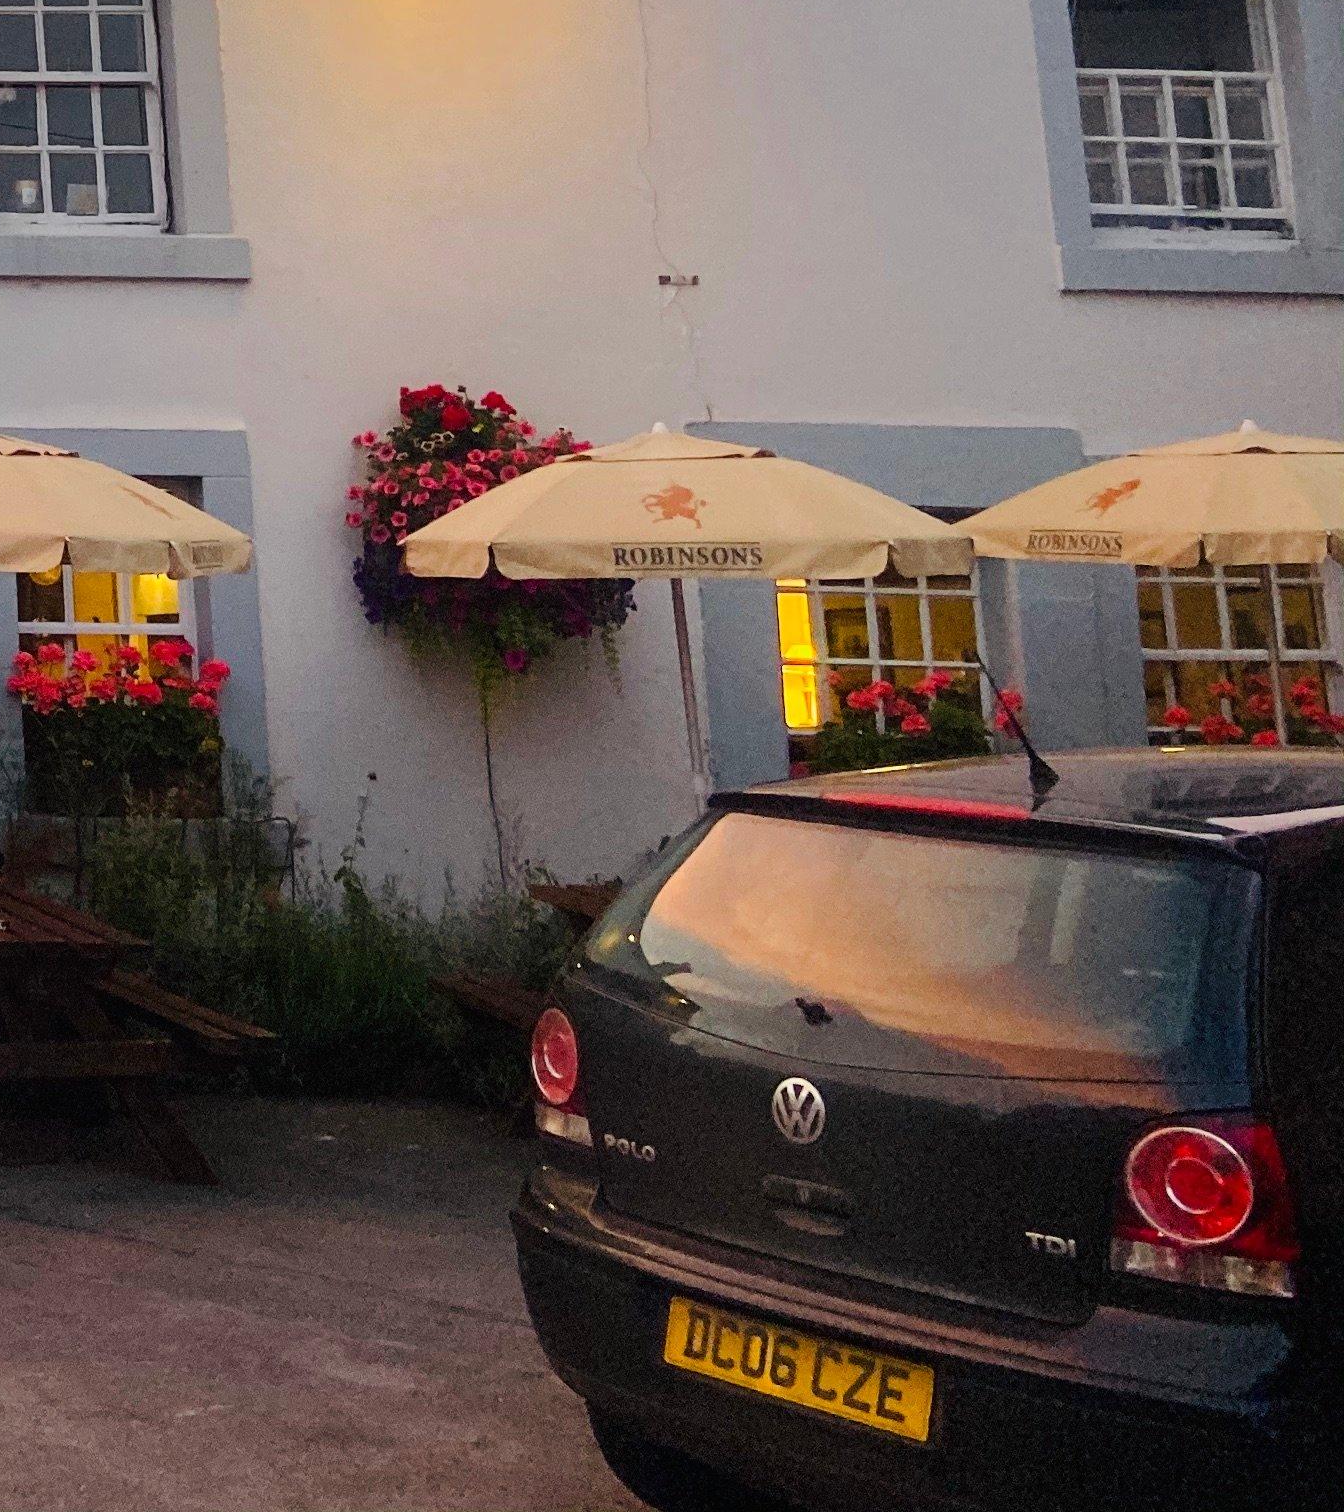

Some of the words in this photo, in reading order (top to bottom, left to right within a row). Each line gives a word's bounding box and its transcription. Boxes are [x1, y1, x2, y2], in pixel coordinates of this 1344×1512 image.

[613, 546, 763, 567] ROBINSONS
[1026, 534, 1124, 554] ROBINSONS
[604, 1133, 656, 1162] POLO
[1025, 1231, 1076, 1258] TDI
[683, 1304, 799, 1389] DC06
[811, 1342, 911, 1423] CZE
